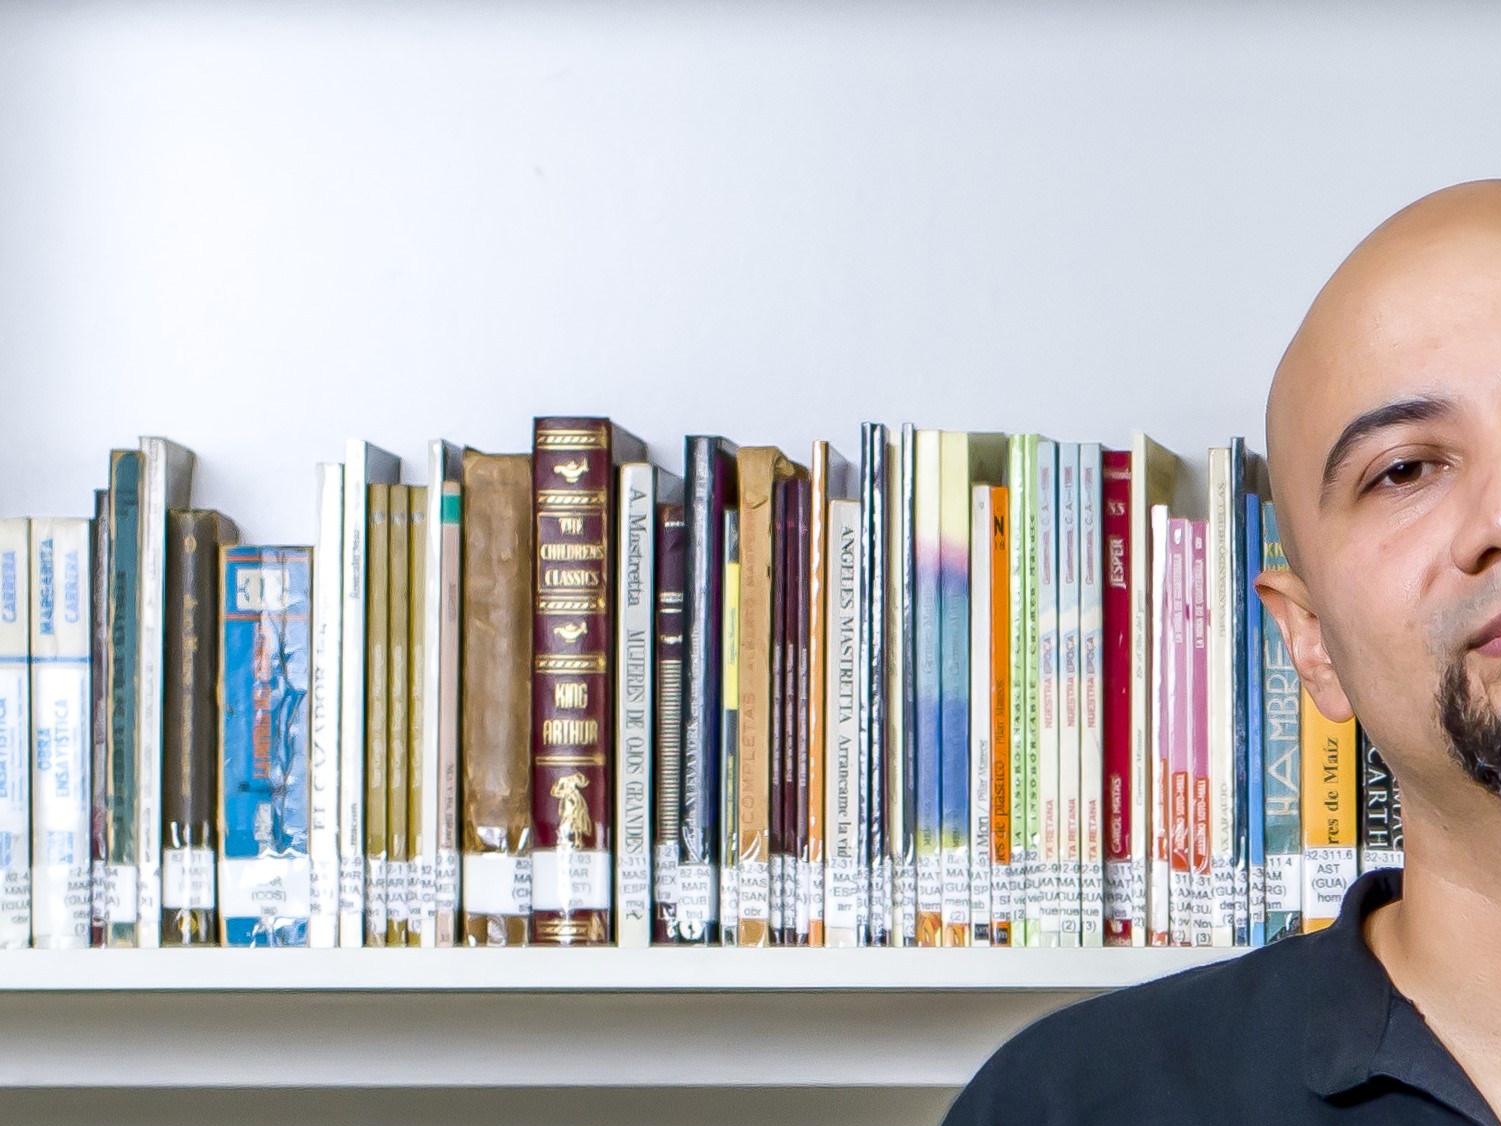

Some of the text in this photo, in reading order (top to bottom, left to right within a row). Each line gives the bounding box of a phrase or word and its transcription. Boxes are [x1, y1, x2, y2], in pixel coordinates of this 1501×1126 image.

[545, 569, 600, 587] CLASSICS
[627, 513, 648, 608] Mastretta
[839, 525, 855, 609] ANGELES
[1109, 539, 1127, 588] JESPER
[839, 616, 855, 725] MASTRETTA
[554, 682, 588, 709] KING
[1043, 676, 1053, 728] NUESTRA
[1067, 675, 1077, 727] NUESTRA
[1087, 676, 1097, 728] NUESTRA
[542, 719, 597, 746] ARTHUR
[626, 629, 646, 854] MUJERES DE OJOS GRANDES
[1045, 799, 1055, 844] RETANA
[1067, 798, 1077, 844] RETANA
[1088, 799, 1098, 844] RETANA
[1110, 776, 1123, 853] CAROL MATAS
[1323, 790, 1340, 813] de
[838, 821, 855, 835] la
[681, 882, 708, 892] MAR
[741, 878, 768, 889] MAS
[1311, 877, 1347, 891] (GUA)
[1316, 863, 1339, 874] AST
[1317, 891, 1343, 903] hom
[1061, 920, 1077, 932] (2)
